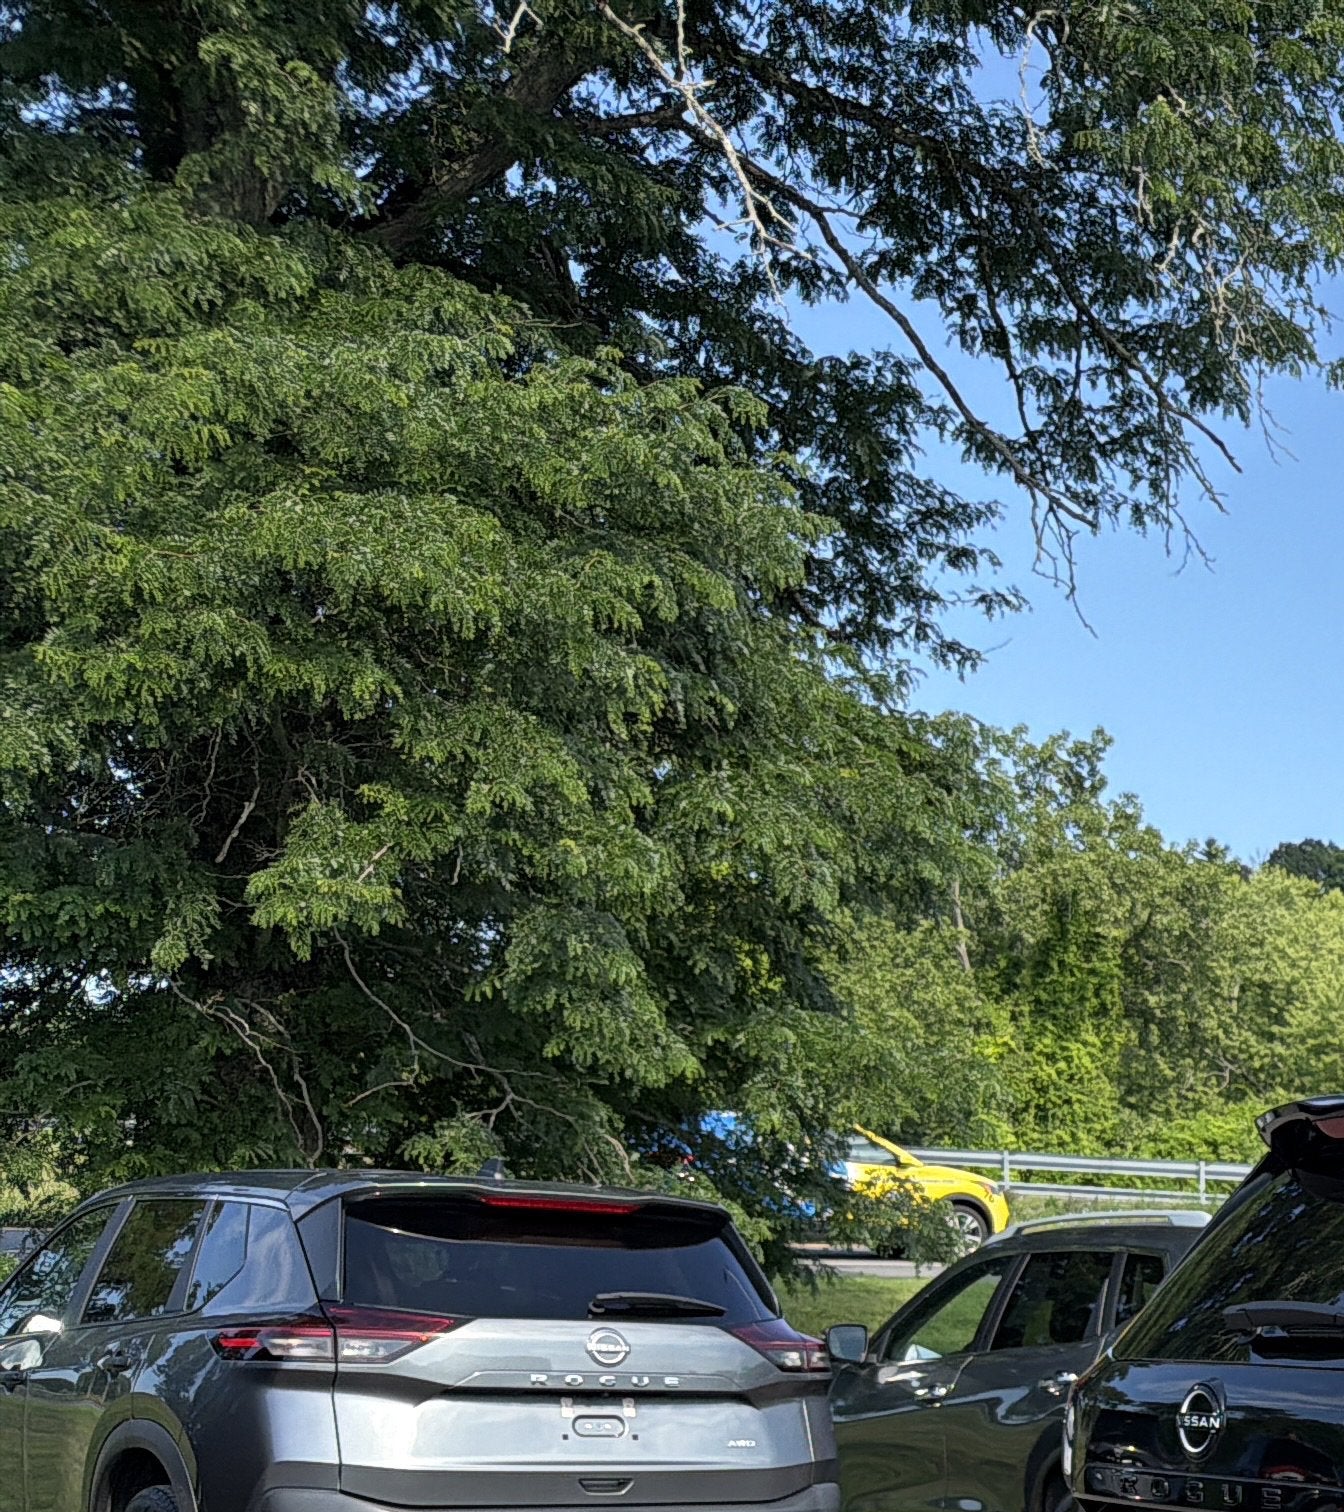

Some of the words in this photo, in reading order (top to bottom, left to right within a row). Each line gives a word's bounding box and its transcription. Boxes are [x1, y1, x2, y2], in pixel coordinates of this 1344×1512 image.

[530, 1373, 681, 1387] ROGUE
[727, 1439, 756, 1448] AWD
[1119, 1475, 1282, 1510] ROGUE
